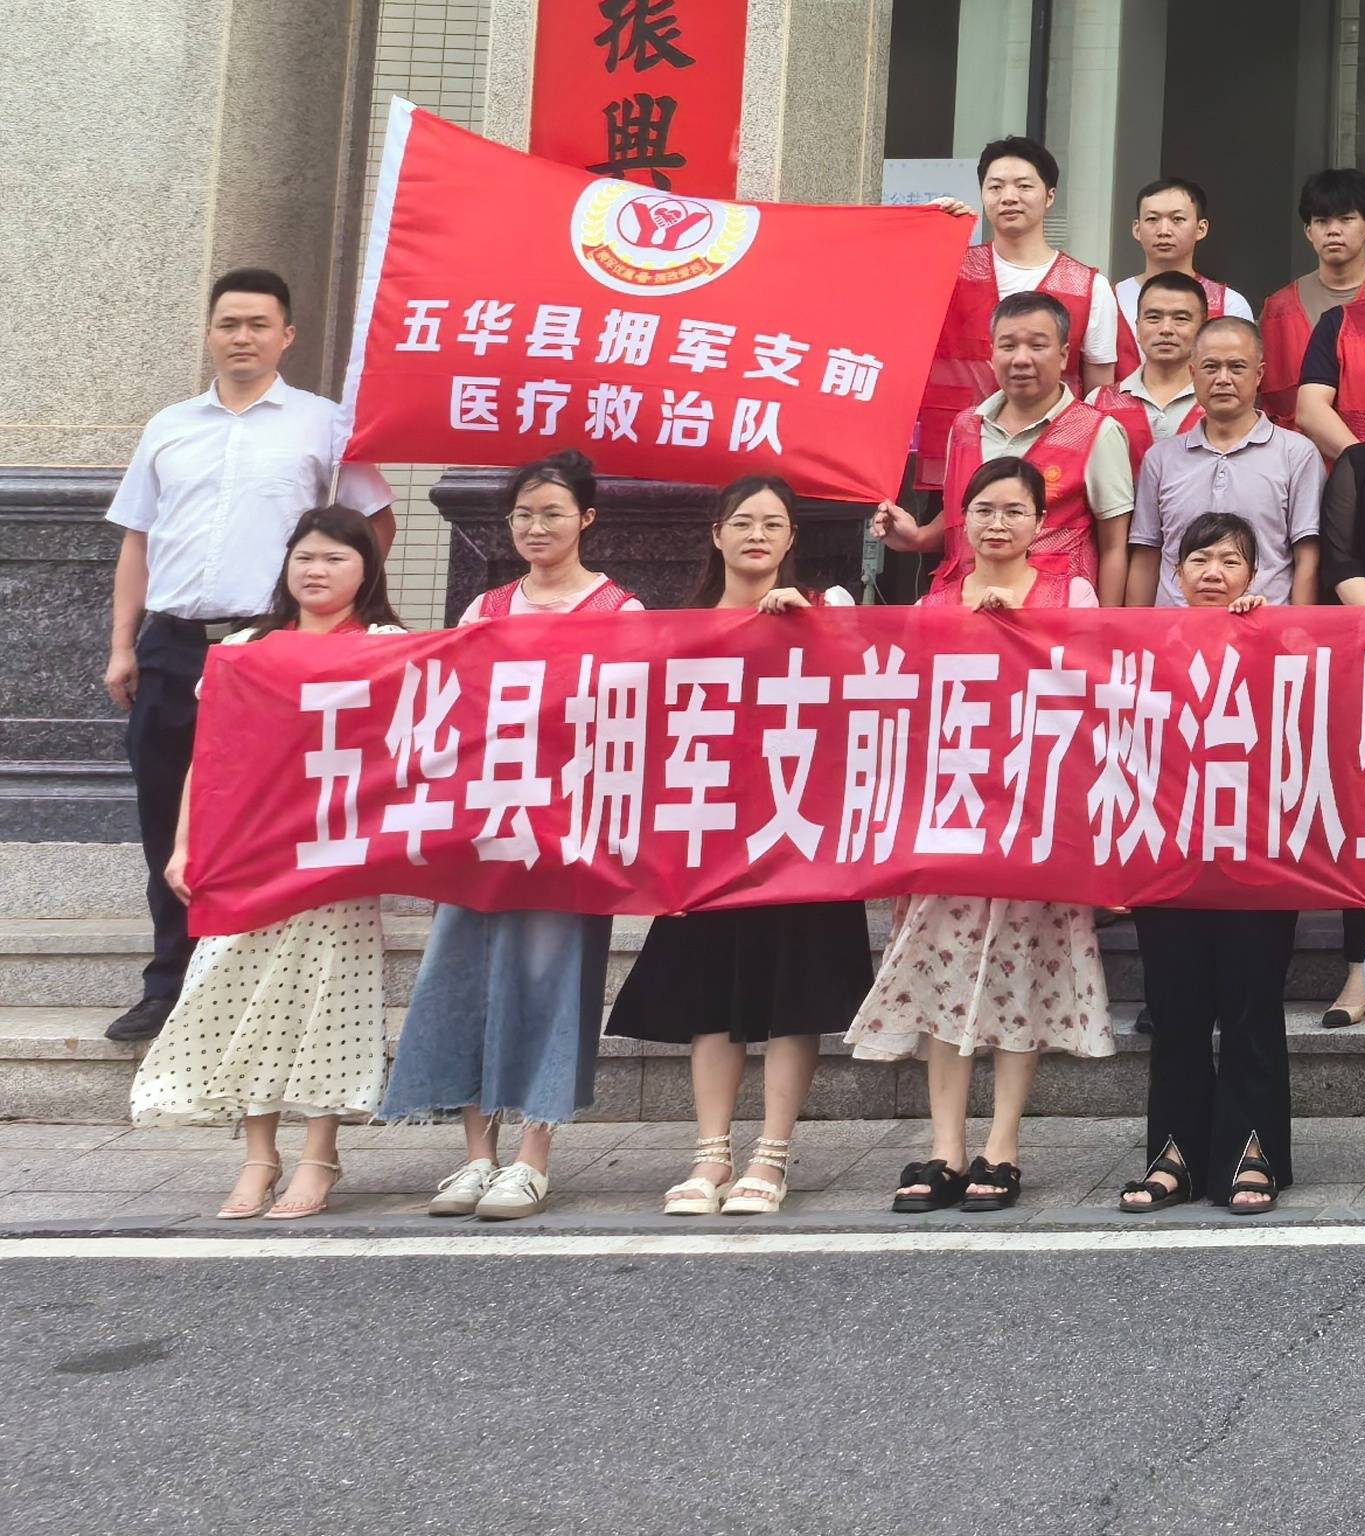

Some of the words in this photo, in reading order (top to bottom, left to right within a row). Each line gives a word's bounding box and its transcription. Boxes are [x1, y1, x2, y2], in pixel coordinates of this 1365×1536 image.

[396, 298, 884, 402] 五华县拥军支前
[450, 375, 784, 456] 医疗救治队
